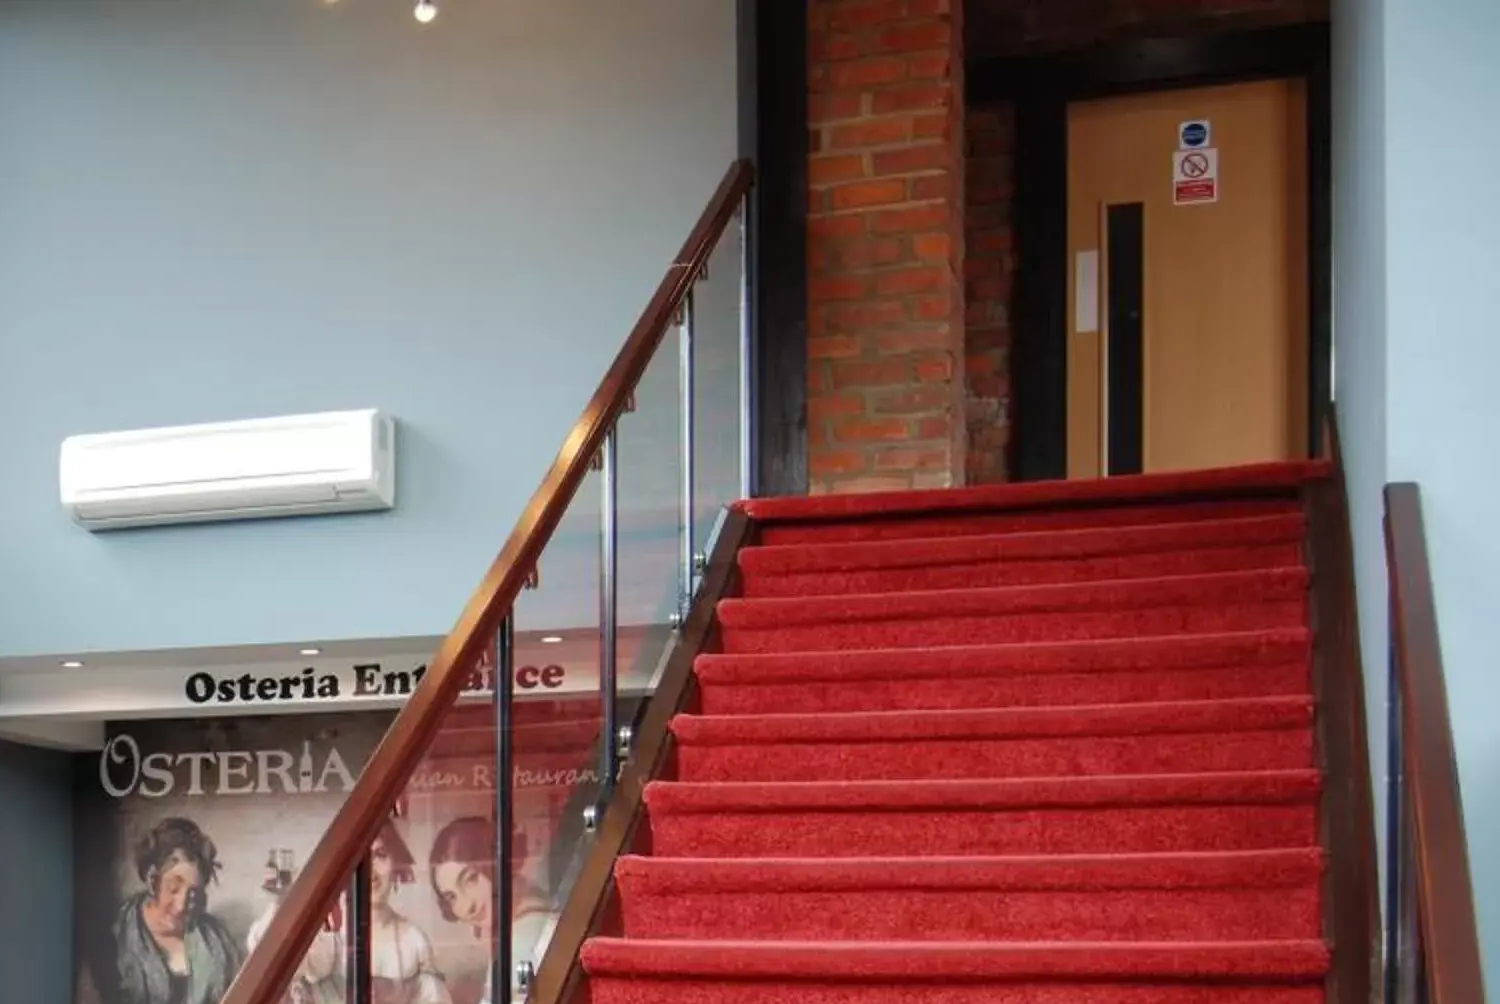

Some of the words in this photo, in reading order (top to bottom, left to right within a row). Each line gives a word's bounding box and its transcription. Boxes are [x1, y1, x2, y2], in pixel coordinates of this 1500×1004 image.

[185, 667, 340, 703] Osteria
[353, 663, 565, 696] Entace
[100, 734, 356, 797] OSTERIA
[472, 763, 609, 788] Rtauran
